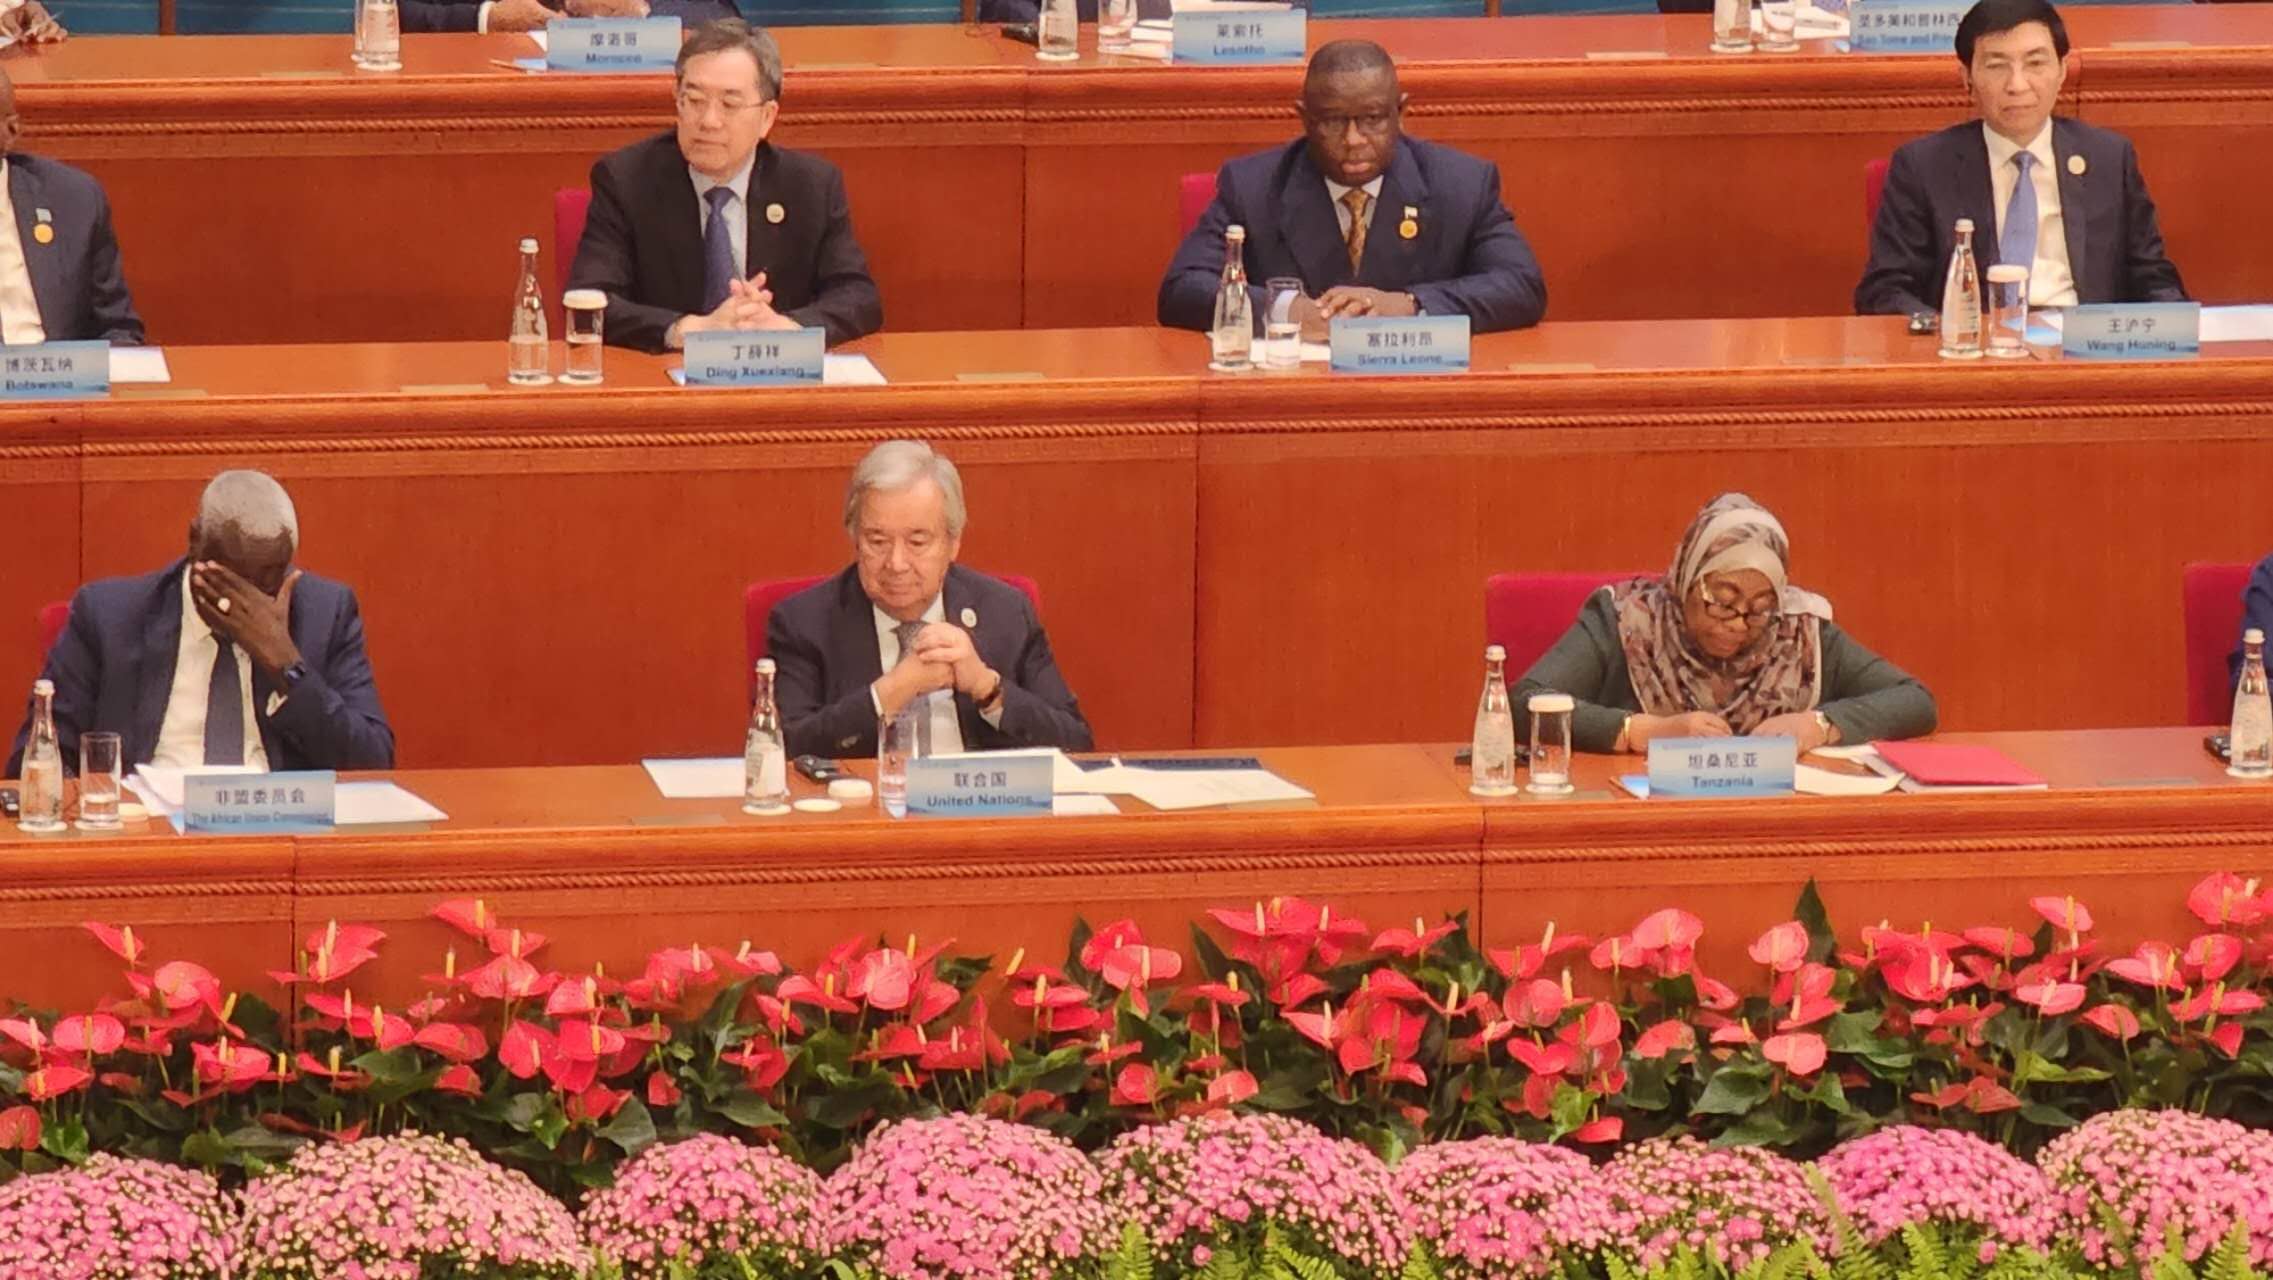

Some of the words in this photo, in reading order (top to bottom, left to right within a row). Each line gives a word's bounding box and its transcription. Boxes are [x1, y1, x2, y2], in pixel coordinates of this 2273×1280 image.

[1217, 23, 1264, 37] 莱索托
[590, 32, 637, 46] 摩洛哥
[1213, 44, 1265, 56] Lesotho
[585, 52, 642, 64] Morocco
[2108, 317, 2155, 333] 王沪宁
[1367, 332, 1432, 347] 塞拉利昂
[2087, 340, 2124, 354] Wang
[2128, 339, 2177, 352] Huning
[731, 345, 779, 360] 丁薛祥
[1358, 354, 1397, 365] Sierra
[1401, 353, 1442, 364] Leone
[6, 356, 73, 372] 博茨瓦纳
[706, 367, 737, 380] Ding
[742, 366, 805, 378] Xuexiang
[6, 379, 74, 391] Botswana
[1689, 752, 1758, 769] 坦桑尼亚
[954, 772, 1007, 788] 联合国
[1692, 775, 1754, 788] Tanzania
[216, 788, 305, 805] 非盟委员会
[927, 795, 973, 807] United
[978, 794, 1033, 805] Nations
